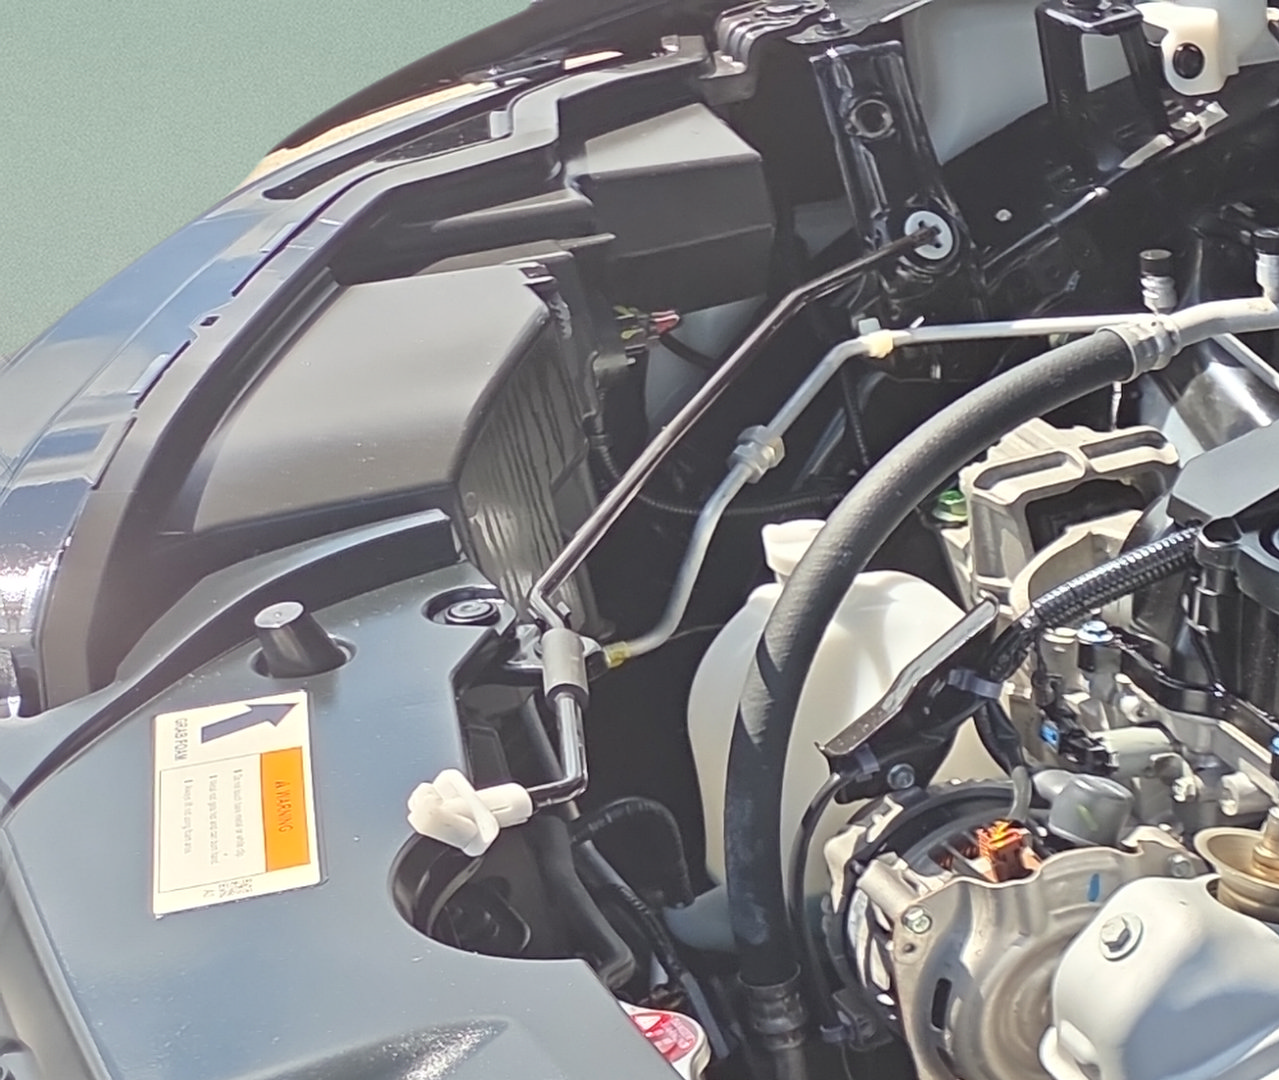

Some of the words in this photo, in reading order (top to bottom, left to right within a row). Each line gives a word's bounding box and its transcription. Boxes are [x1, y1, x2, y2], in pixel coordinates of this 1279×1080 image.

[175, 718, 188, 738] GRAB
[174, 739, 188, 761] FOAM
[274, 790, 294, 833] WARNING
